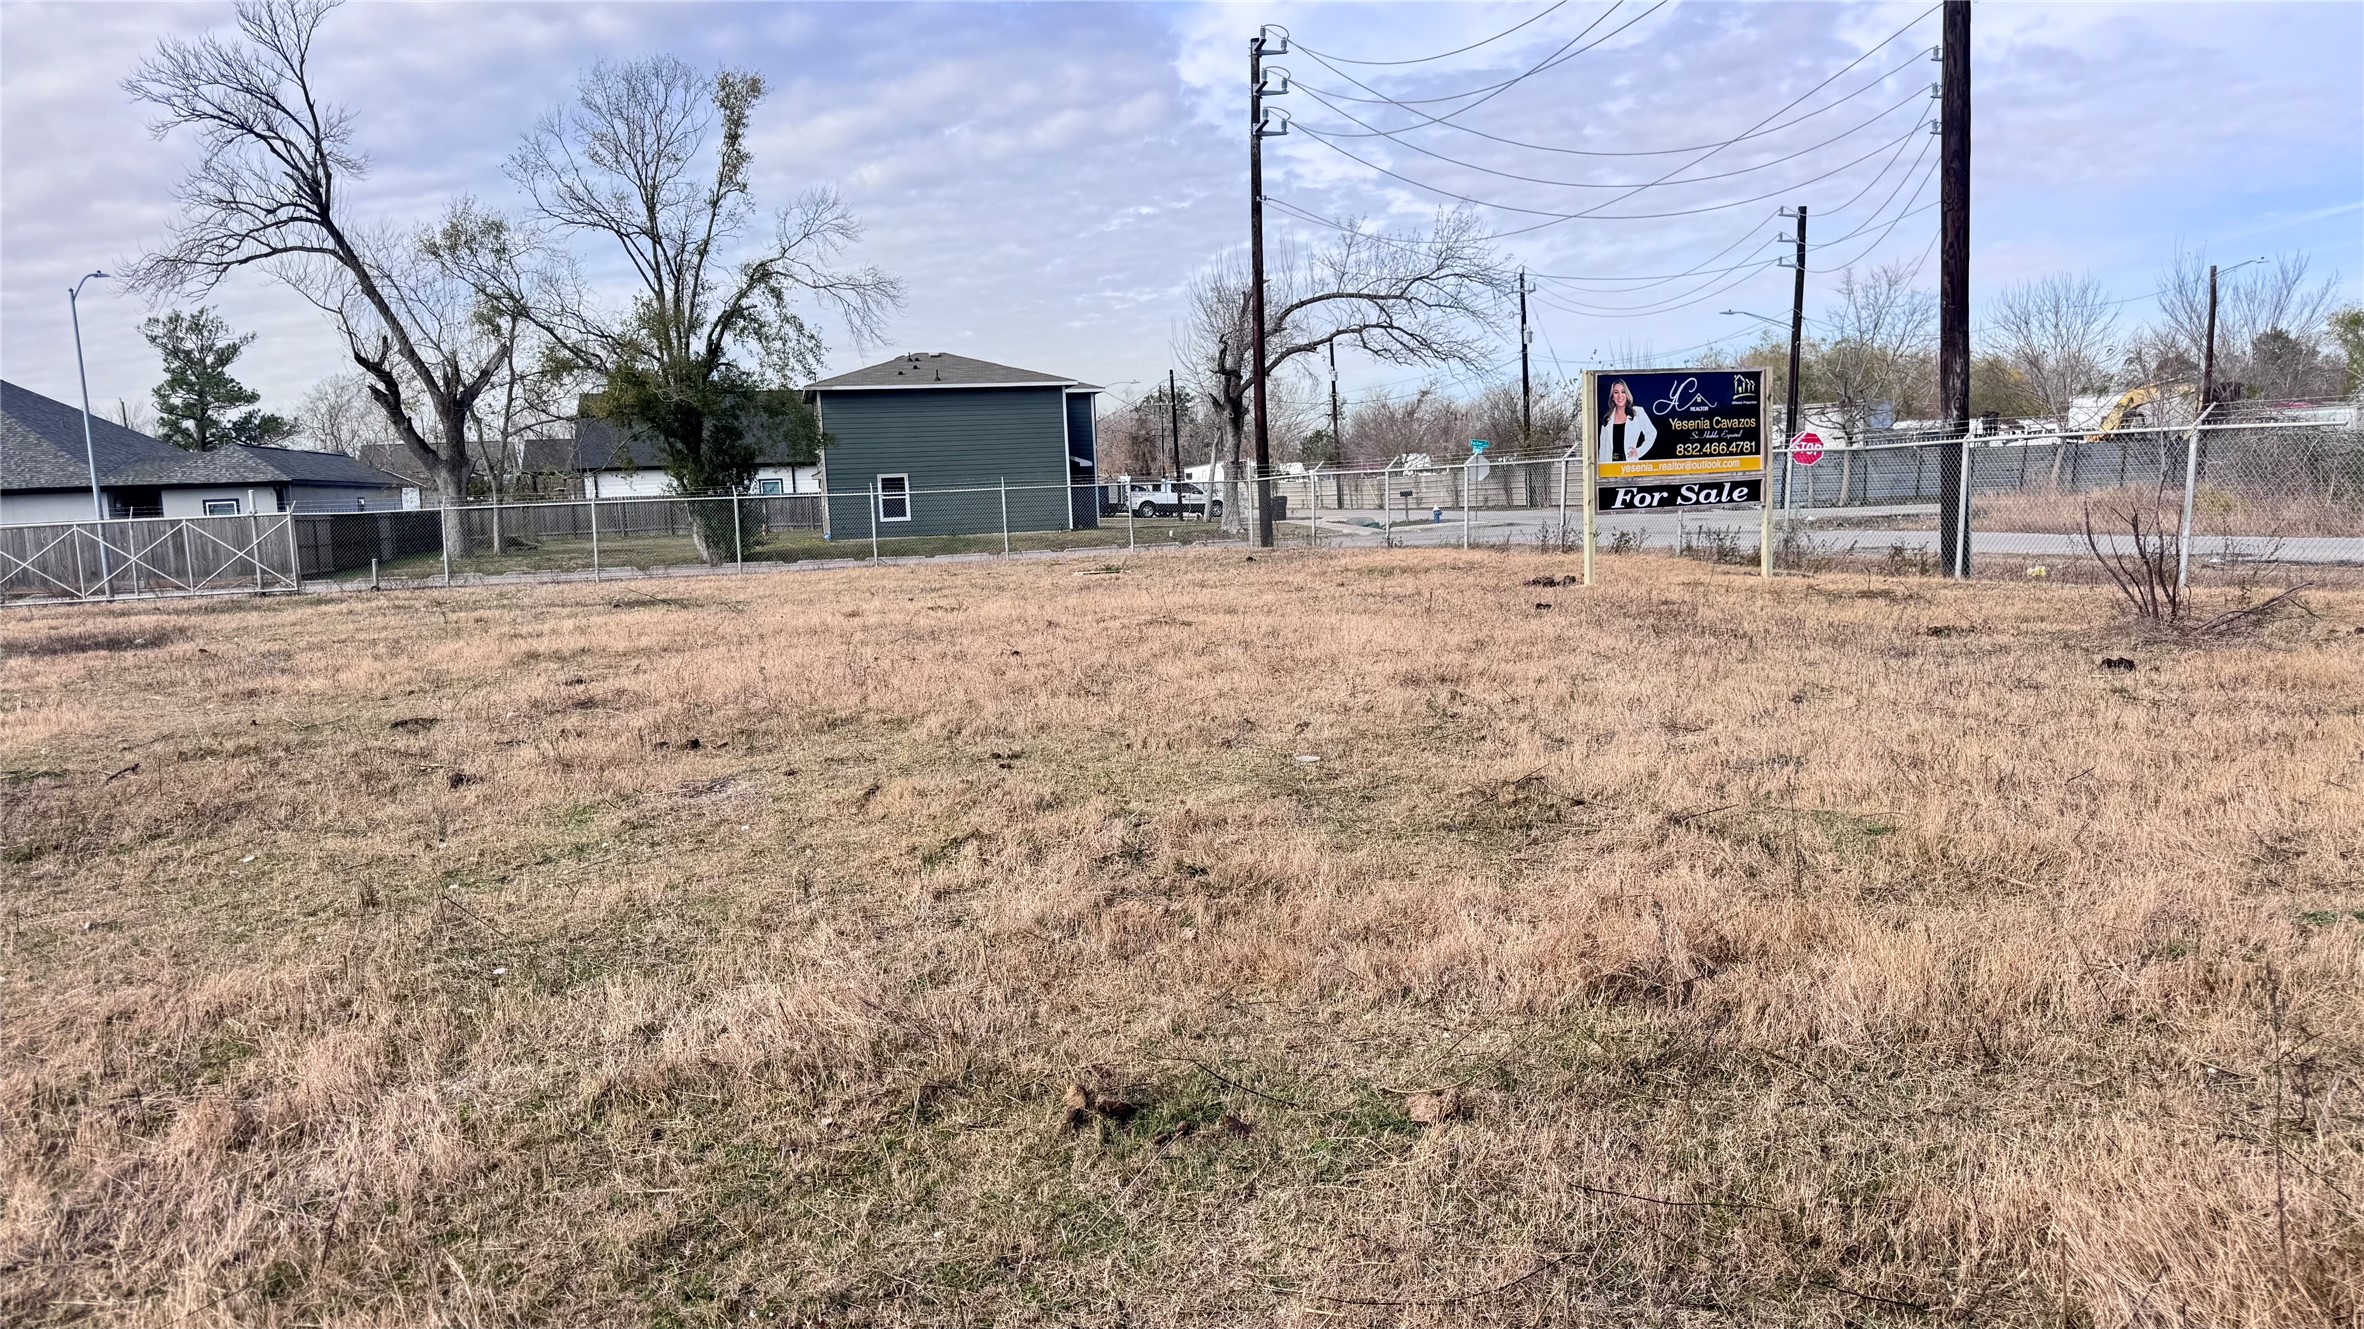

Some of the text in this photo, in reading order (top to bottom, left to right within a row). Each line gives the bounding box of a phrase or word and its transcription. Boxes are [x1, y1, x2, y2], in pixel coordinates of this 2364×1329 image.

[1669, 416, 1756, 430] Yesenia Cavazos
[1676, 441, 1755, 456] 832.466.4781
[1611, 482, 1749, 509] For Sale
